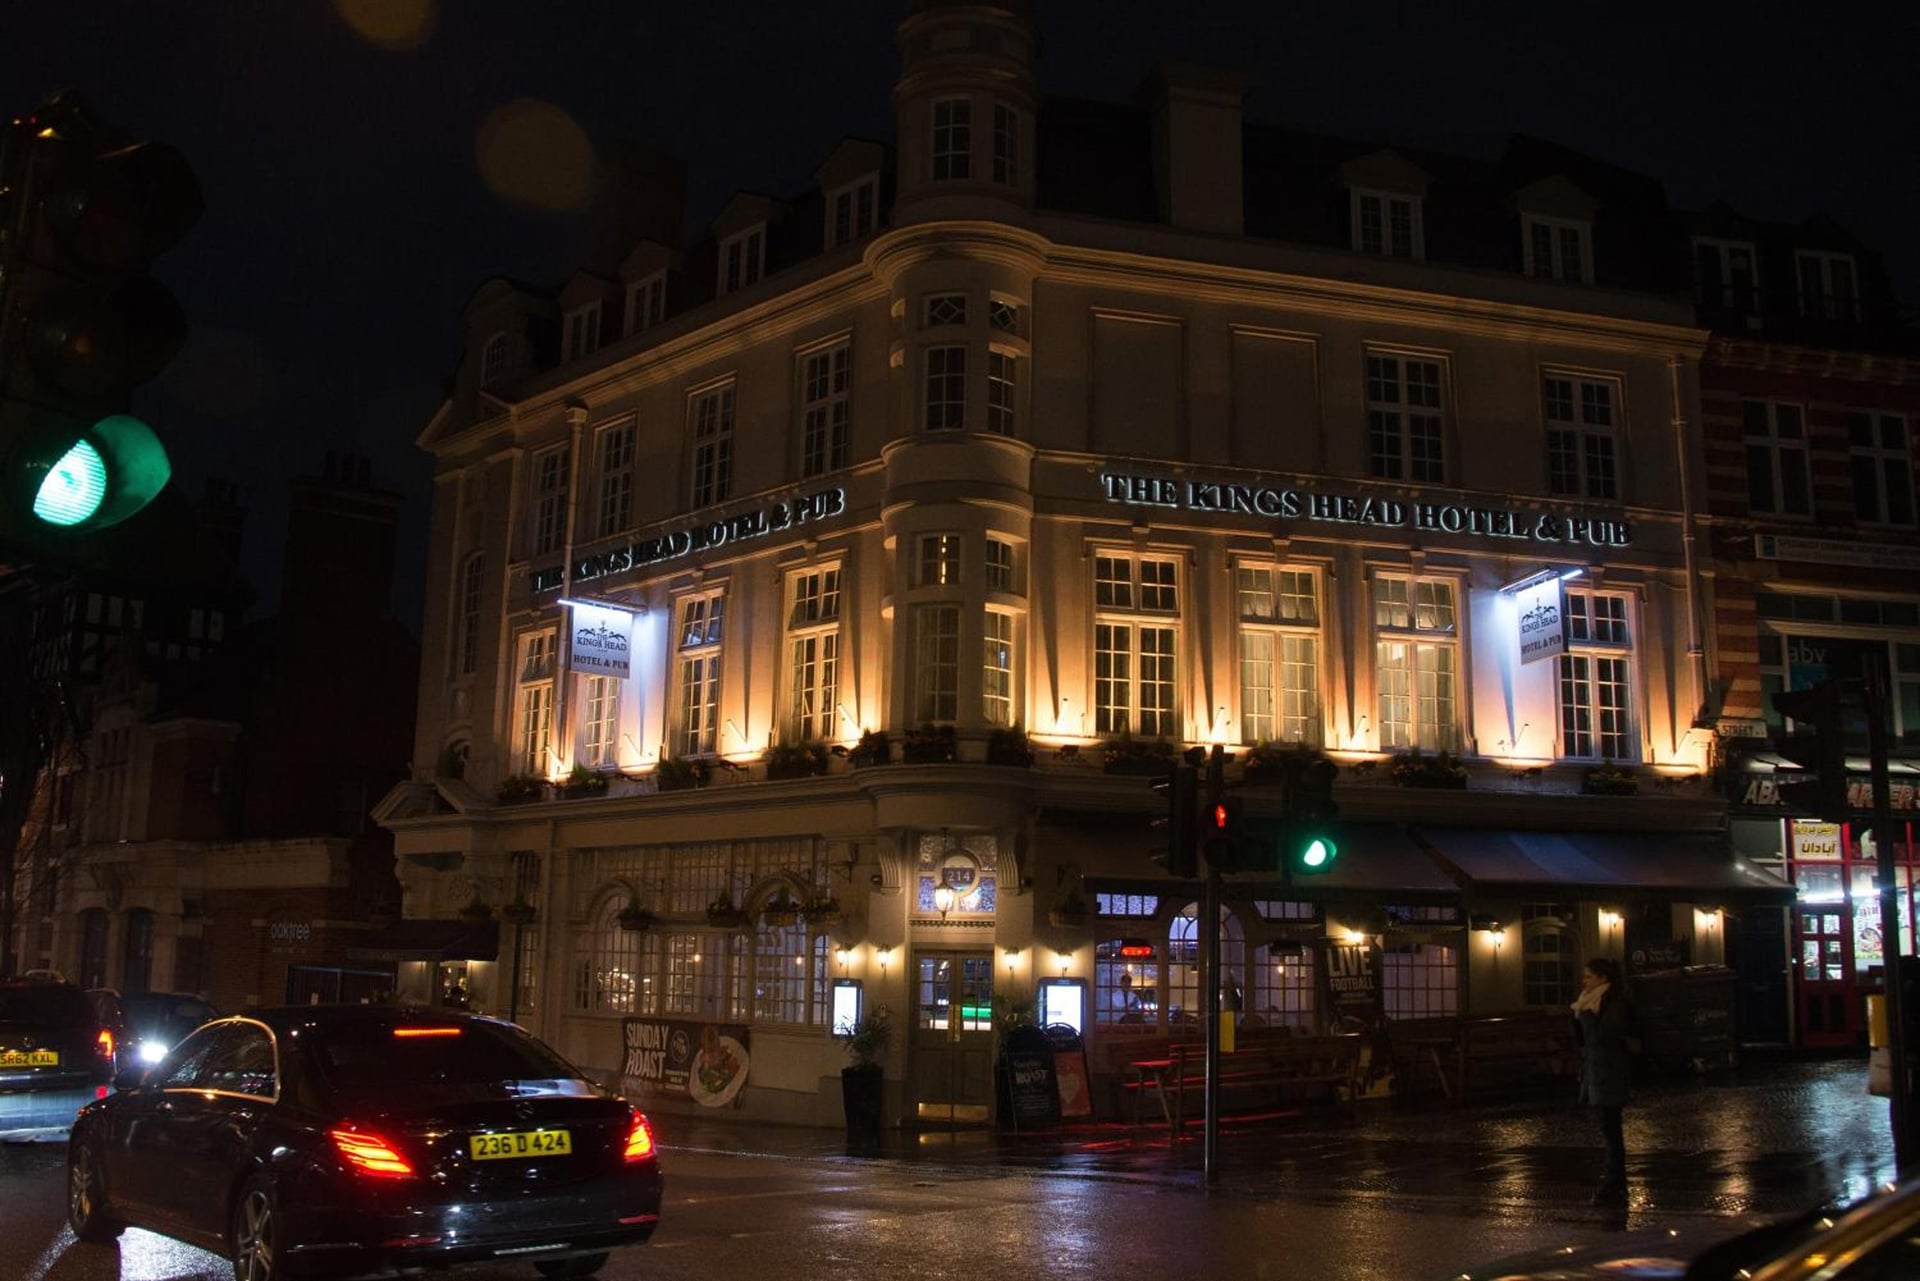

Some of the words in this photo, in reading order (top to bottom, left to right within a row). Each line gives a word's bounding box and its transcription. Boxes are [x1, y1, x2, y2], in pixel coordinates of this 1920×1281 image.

[770, 503, 791, 531] &
[794, 488, 845, 524] PUB
[1101, 473, 1178, 508] THE
[1186, 481, 1301, 518] KINGS
[1308, 493, 1408, 527] HEAD
[1414, 503, 1529, 540] HOTEL
[1535, 511, 1561, 542] &
[1566, 517, 1632, 547] PUB
[1540, 614, 1559, 628] HEAD
[576, 636, 602, 649] KINGS
[604, 642, 627, 652] HEAD
[1521, 640, 1542, 655] HOTEL
[573, 654, 602, 667] HOTEL
[603, 660, 611, 668] &
[612, 660, 629, 670] PUB
[1722, 724, 1753, 736] STREET
[949, 869, 971, 882] 214
[1326, 945, 1373, 976] LIVE
[1329, 975, 1375, 993] FOOTBALL
[626, 1022, 669, 1050] SUNDAY
[32, 1053, 54, 1064] KXL
[625, 1048, 667, 1079] ROAST
[475, 1135, 513, 1156] 236
[516, 1134, 528, 1153] D
[532, 1133, 566, 1151] 424
